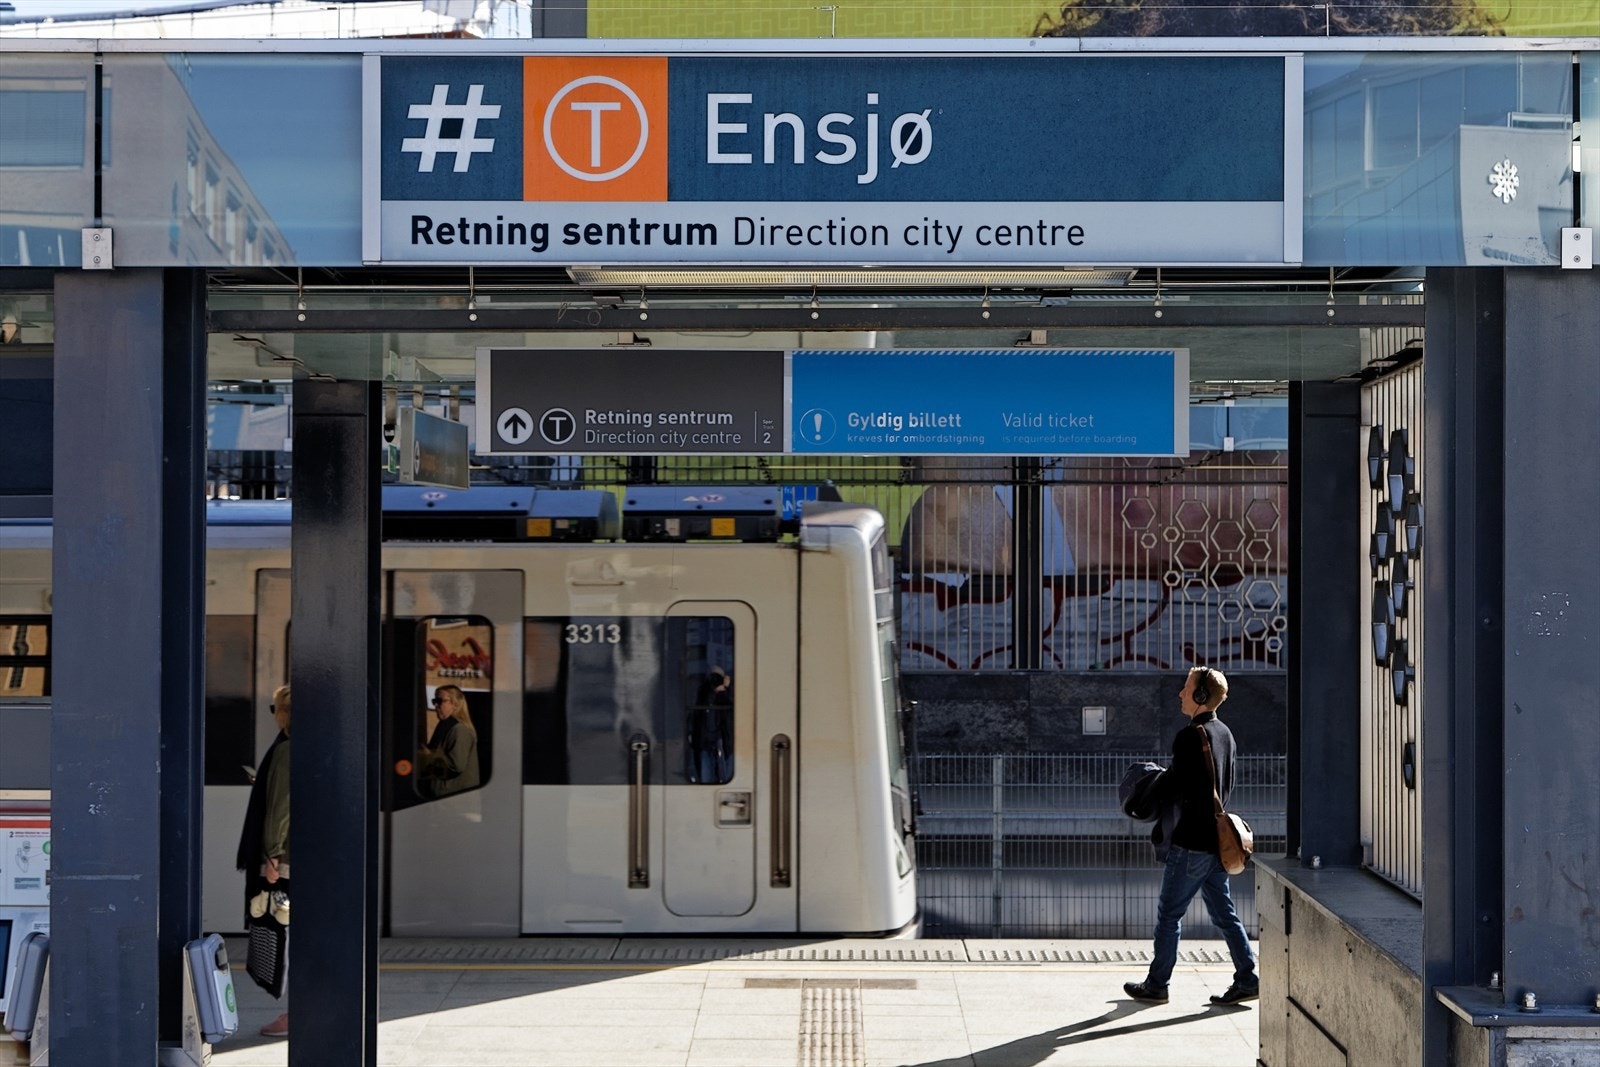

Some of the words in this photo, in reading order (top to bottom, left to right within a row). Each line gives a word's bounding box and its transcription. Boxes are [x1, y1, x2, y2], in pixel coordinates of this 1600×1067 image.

[707, 92, 934, 185] Ensjø
[411, 214, 549, 253] Retning
[562, 217, 718, 246] sentrum
[734, 216, 889, 247] Direction
[903, 216, 963, 254] city
[976, 219, 1085, 247] centre
[585, 410, 653, 427] Retning
[658, 410, 733, 425] sentrum
[847, 412, 903, 431] Gyldig
[909, 412, 962, 428] billett
[1002, 412, 1043, 428] Valid
[1048, 412, 1095, 428] ticket
[585, 429, 655, 444] Direction
[661, 429, 688, 447] city
[692, 431, 742, 444] centre
[763, 432, 771, 444] 2
[847, 434, 882, 443] kreves
[885, 434, 900, 443] før
[903, 434, 985, 445] ombordstigning
[1002, 434, 1011, 443] is
[1014, 434, 1056, 444] required
[1059, 434, 1091, 443] before
[1094, 434, 1137, 445] boarding
[565, 624, 621, 644] 3313
